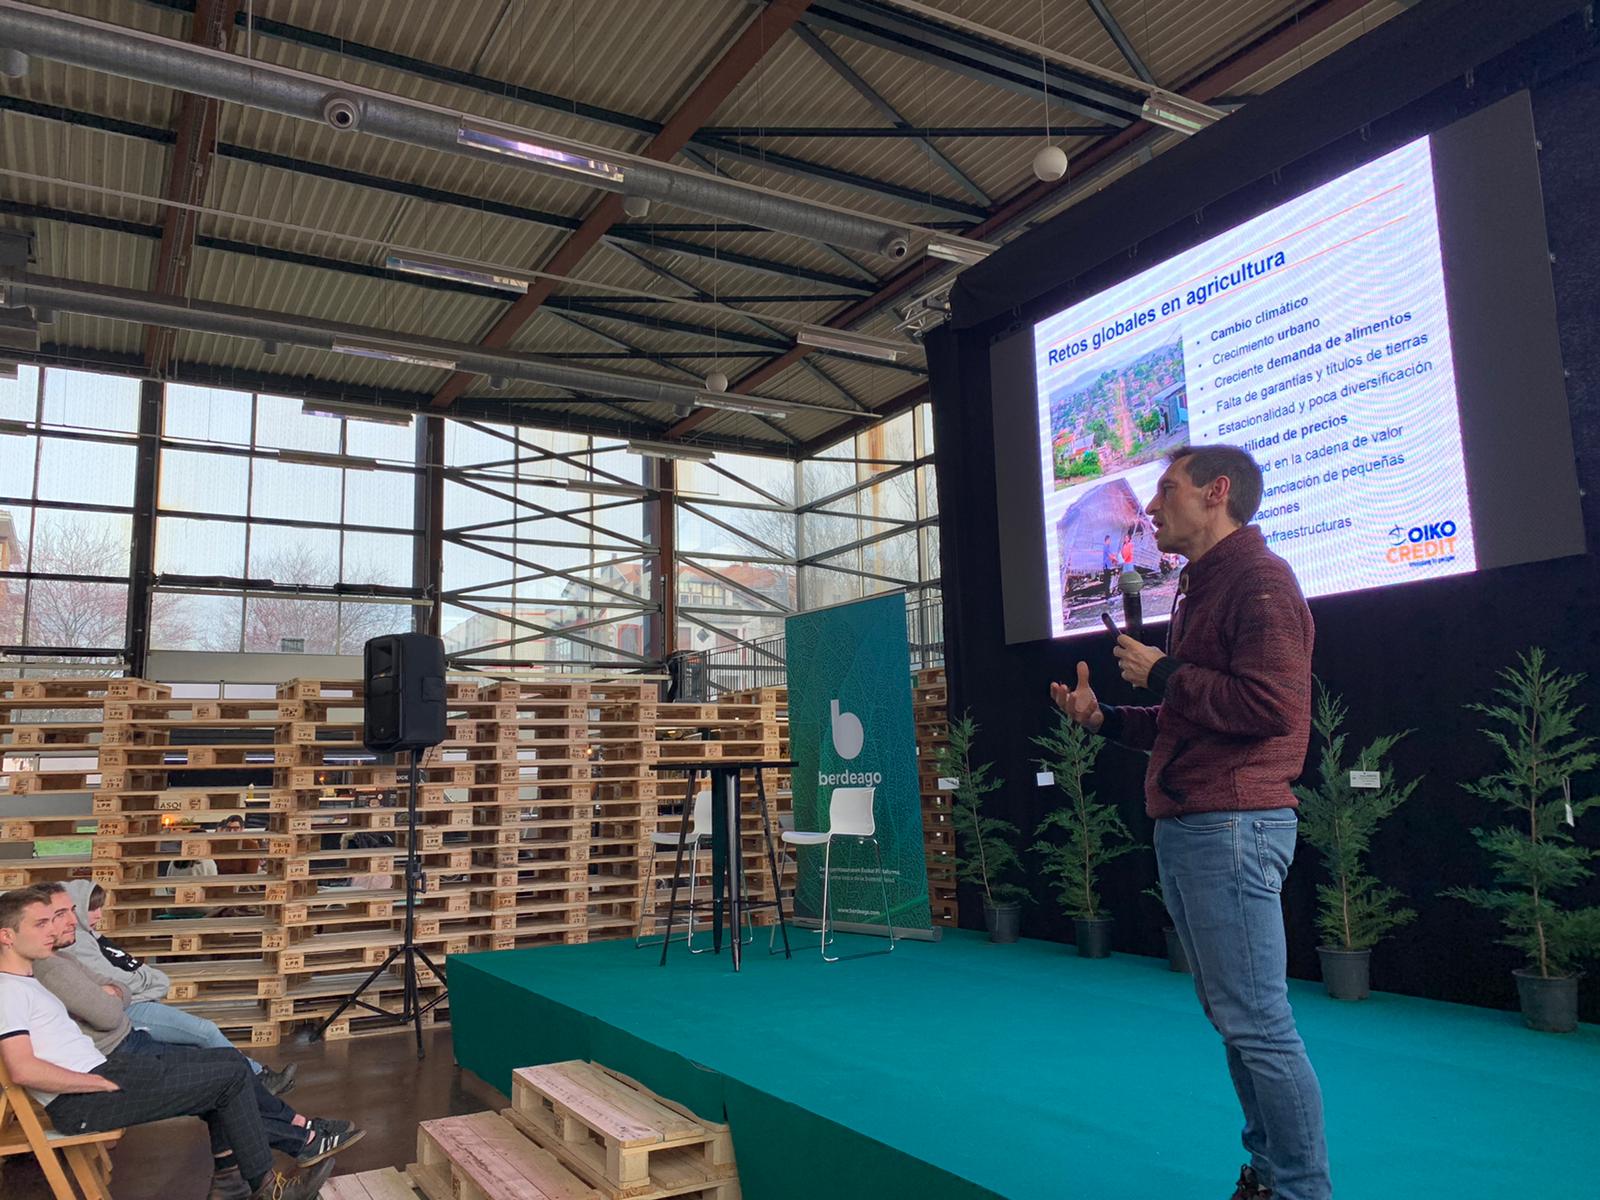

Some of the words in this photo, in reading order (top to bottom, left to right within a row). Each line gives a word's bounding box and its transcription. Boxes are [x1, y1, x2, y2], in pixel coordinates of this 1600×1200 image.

[1048, 338, 1088, 366] Retos
[1092, 308, 1156, 350] globales
[1161, 298, 1181, 316] en
[1186, 251, 1286, 306] agricultura
[1211, 319, 1252, 341] Cambio
[1255, 297, 1308, 324] climático
[1212, 335, 1275, 365] Crecimiento
[1278, 318, 1320, 341] urbano
[1214, 364, 1264, 388] Creciente
[1267, 343, 1322, 370] demanda
[1325, 336, 1341, 349] de
[1345, 311, 1412, 342] alimentos
[1216, 396, 1241, 412] Falta
[1244, 391, 1257, 403] de
[1315, 369, 1323, 383] y
[1366, 349, 1382, 362] de
[1386, 334, 1428, 356] tierras
[1218, 402, 1295, 436] Estacionalidad
[1298, 400, 1305, 414] y
[1309, 391, 1337, 411] poca
[1340, 360, 1433, 397] diversificación
[1240, 432, 1280, 451] tilidad
[1283, 429, 1297, 441] de
[1301, 414, 1348, 439] precios
[1274, 457, 1288, 470] en
[1291, 453, 1302, 466] la
[1305, 441, 1349, 462] cadena
[1352, 435, 1368, 449] de
[1371, 425, 1404, 443] valor
[1323, 471, 1338, 483] de
[1342, 454, 1405, 480] pequeñas
[1265, 517, 1352, 545] nfraestructuras
[1386, 537, 1456, 564] CREDIT
[1408, 520, 1456, 542] OIKO
[818, 769, 882, 787] berdeago
